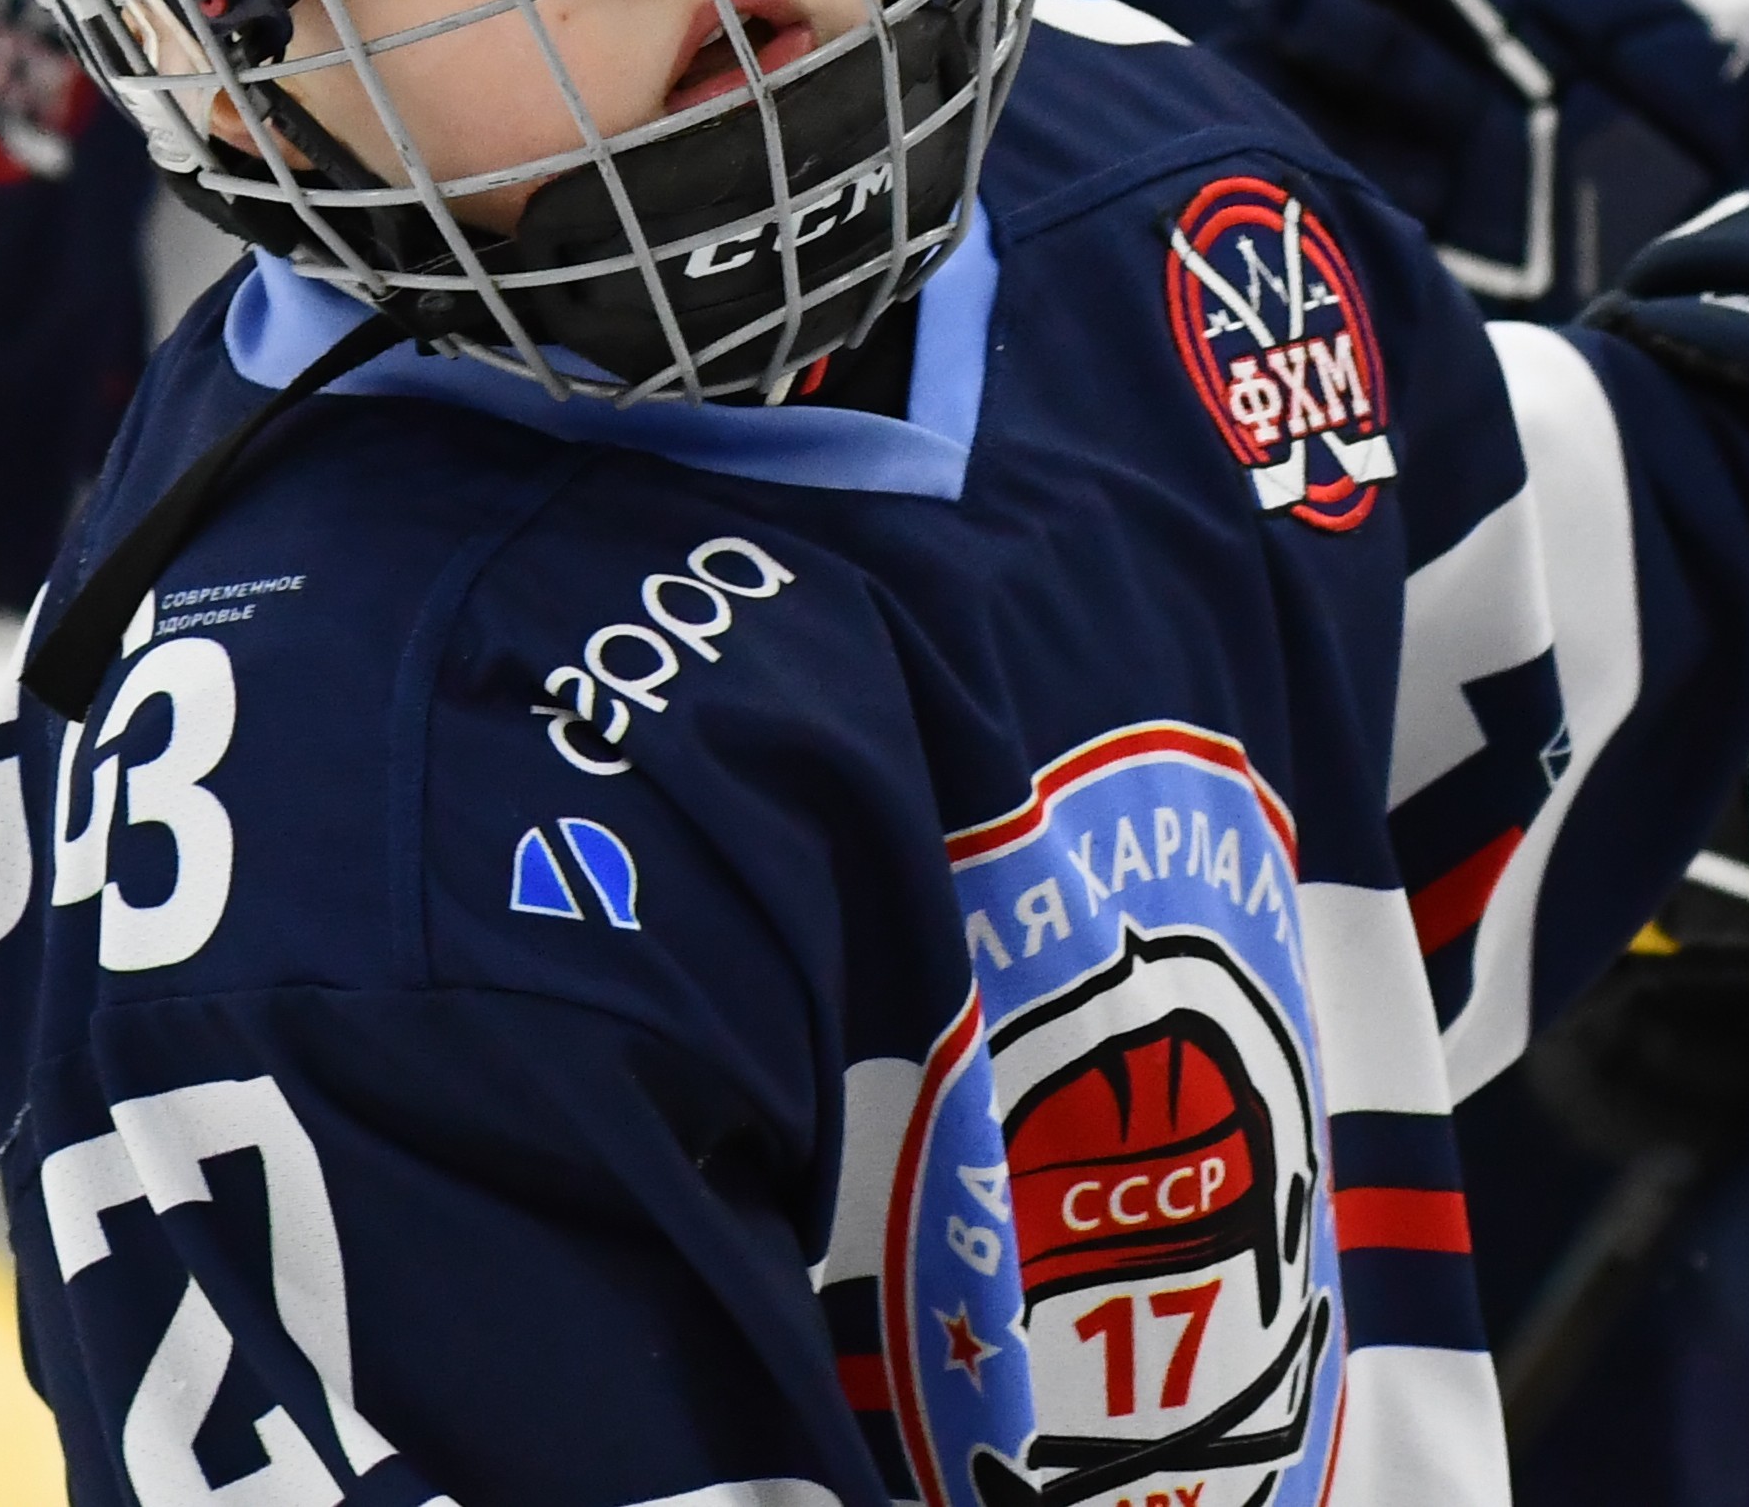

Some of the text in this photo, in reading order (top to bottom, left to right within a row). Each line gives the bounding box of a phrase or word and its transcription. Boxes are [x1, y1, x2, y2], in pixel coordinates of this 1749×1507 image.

[681, 160, 896, 279] CCM
[1227, 332, 1372, 443] ФХМ
[153, 604, 257, 637] ЗДОРОВЬЕ
[161, 575, 307, 611] СОВРЕМЕННОЕ
[1061, 1155, 1227, 1234] СССР
[40, 1074, 400, 1507] 27
[1073, 1278, 1225, 1420] 17
